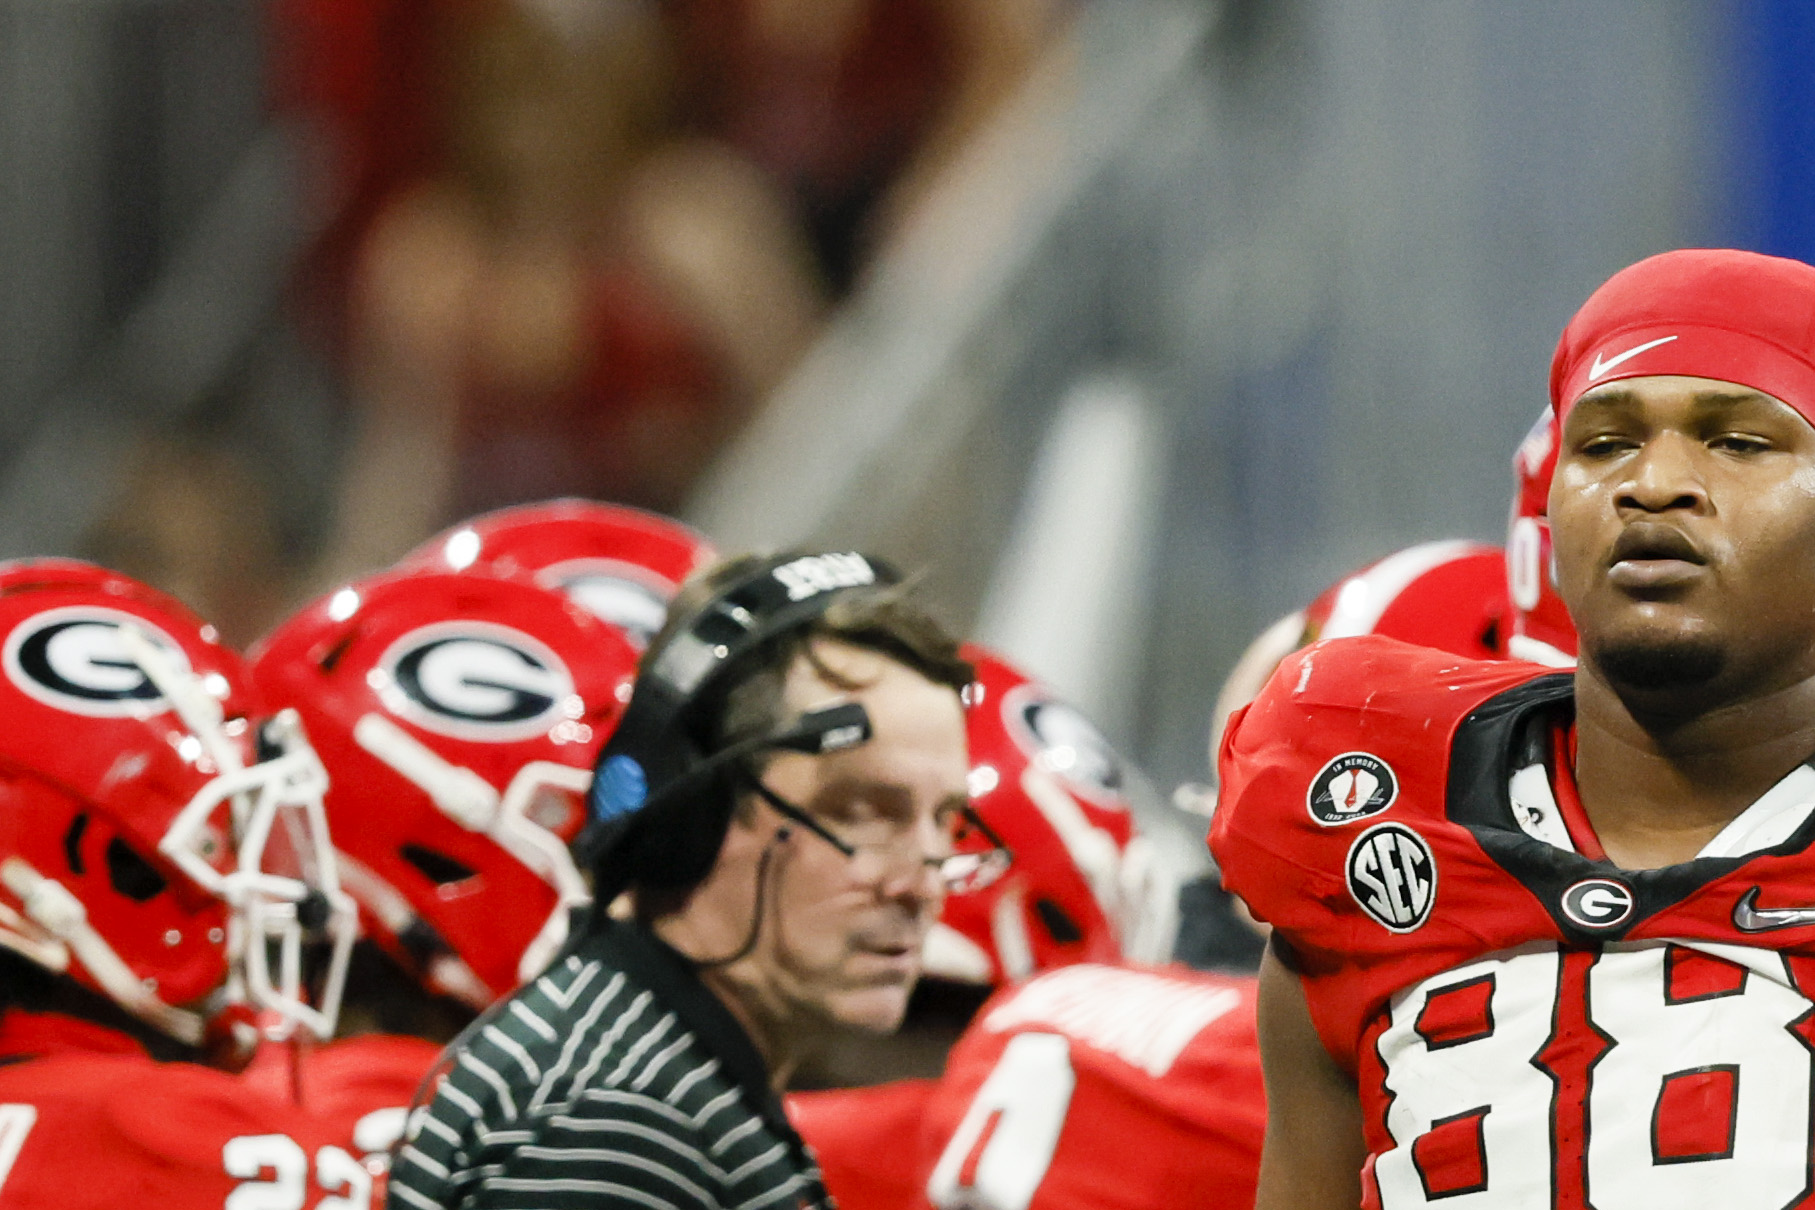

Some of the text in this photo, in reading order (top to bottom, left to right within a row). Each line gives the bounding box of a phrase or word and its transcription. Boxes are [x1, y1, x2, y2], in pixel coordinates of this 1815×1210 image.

[388, 634, 562, 726] G
[1344, 757, 1380, 771] MEMORY
[1353, 831, 1430, 924] SEC
[1563, 880, 1631, 927] G
